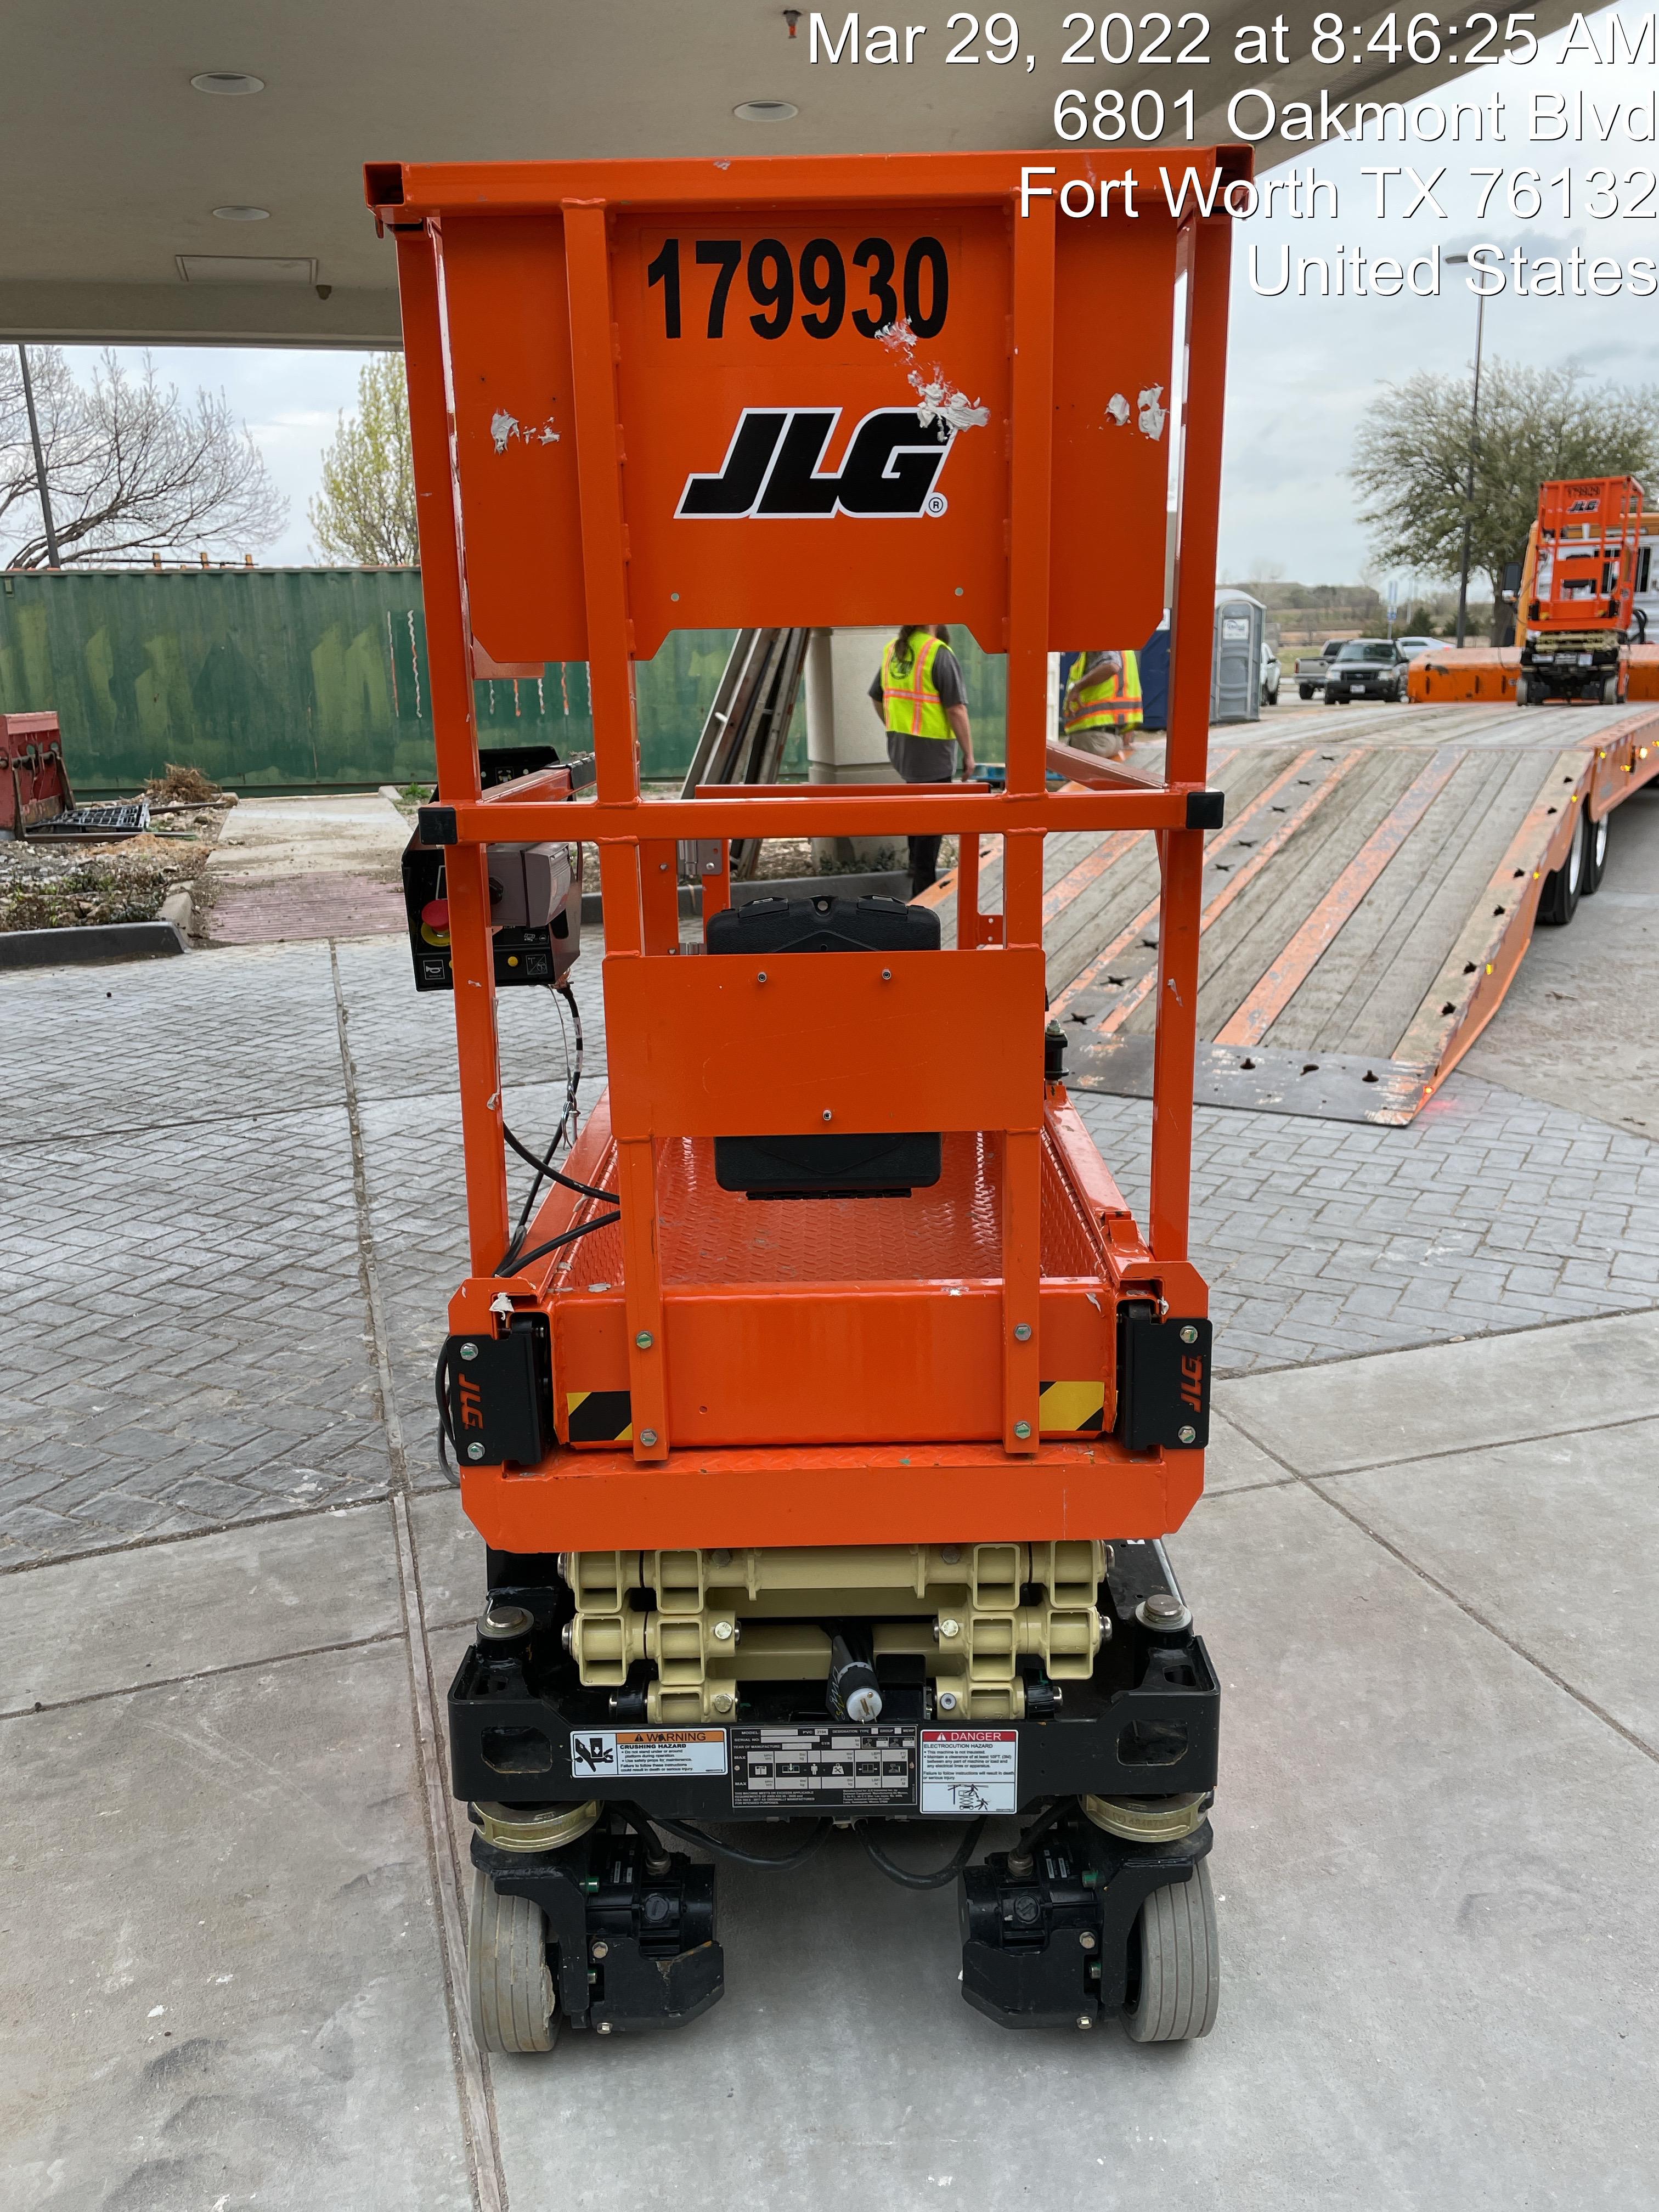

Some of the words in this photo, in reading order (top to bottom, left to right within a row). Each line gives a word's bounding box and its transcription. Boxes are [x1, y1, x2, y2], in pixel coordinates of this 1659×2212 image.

[647, 237, 949, 340] 179930
[674, 407, 961, 519] JLG
[458, 1373, 483, 1430] JLG
[1181, 1355, 1203, 1413] JLG
[951, 1733, 1001, 1741] DANGER
